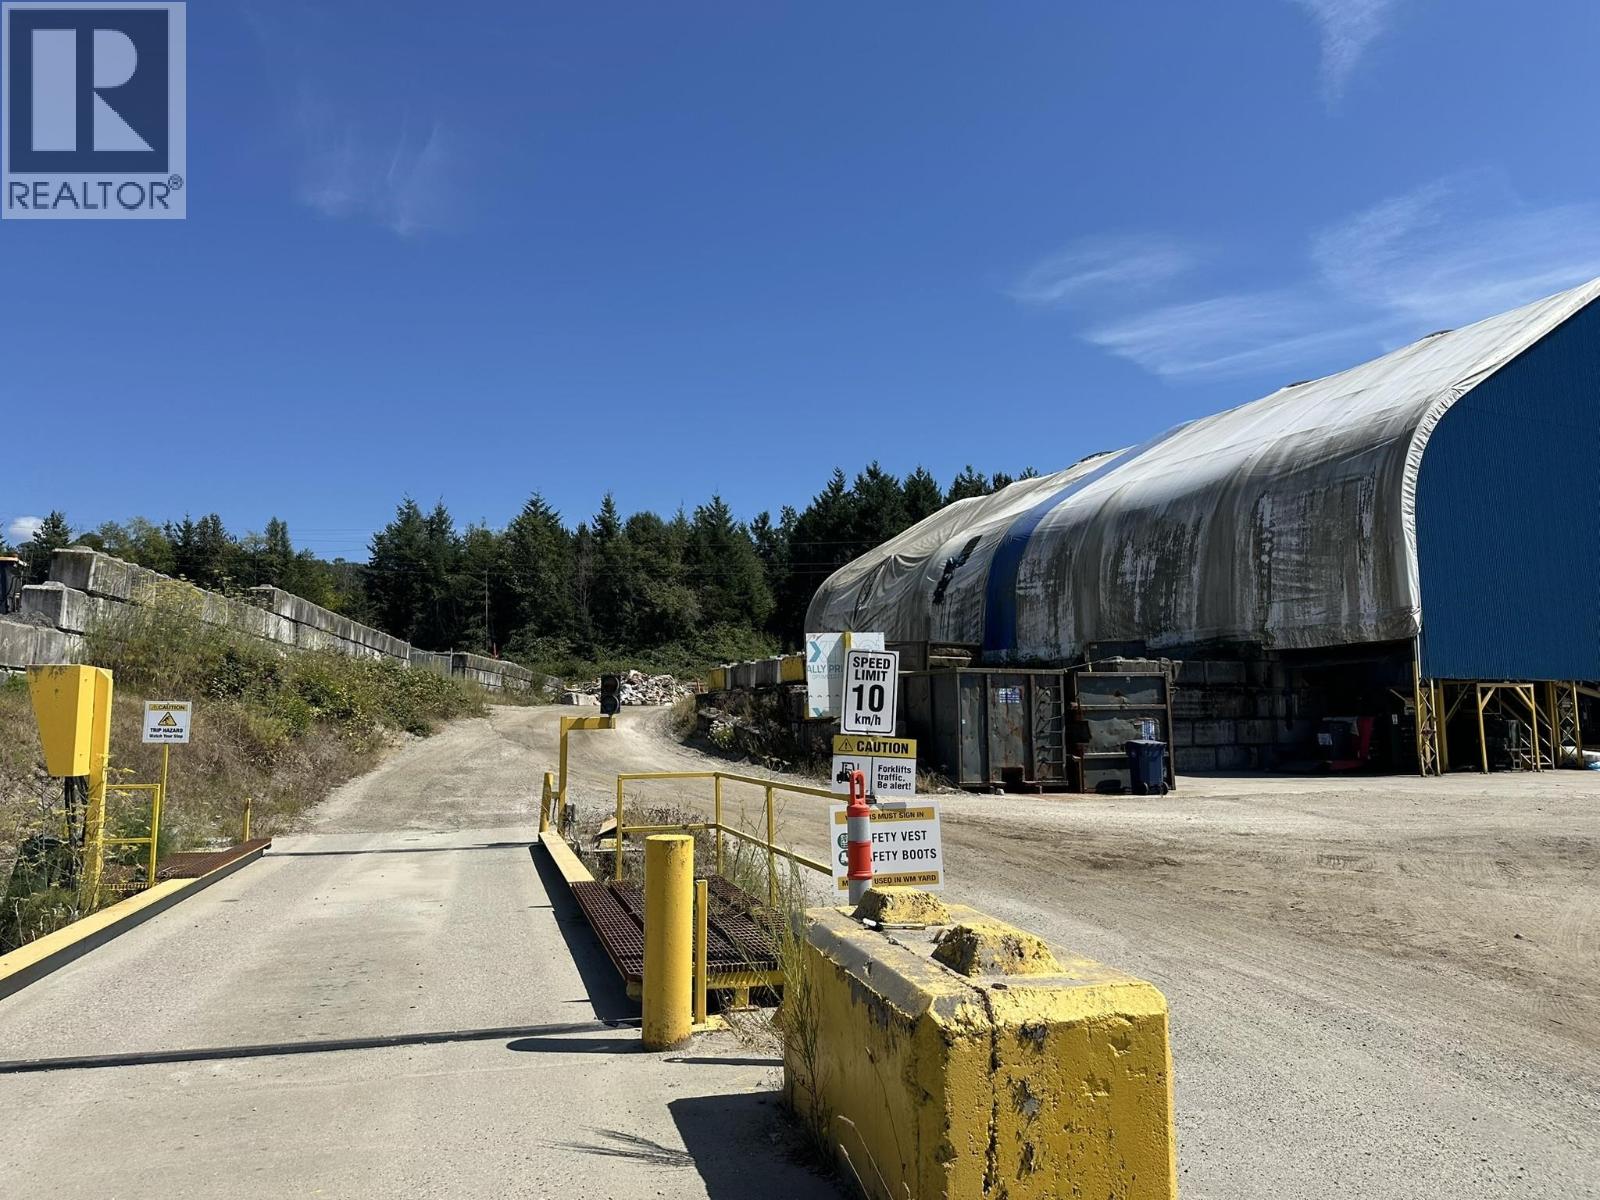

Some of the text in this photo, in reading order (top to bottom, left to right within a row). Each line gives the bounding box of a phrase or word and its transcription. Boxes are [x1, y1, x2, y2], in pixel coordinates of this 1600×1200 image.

[853, 657, 891, 669] SPEED
[855, 669, 888, 682] LIMIT
[852, 684, 885, 712] 10
[854, 713, 881, 726] km/h
[856, 740, 909, 754] CAUTION
[877, 764, 912, 774] Forklifts
[877, 773, 906, 782] traffic.
[877, 781, 912, 790] Be alert!
[899, 811, 916, 819] SIGN
[872, 830, 927, 843] FETY VEST
[871, 848, 937, 862] FETY BOOTS
[874, 876, 893, 885] USED
[918, 874, 937, 882] YARD
